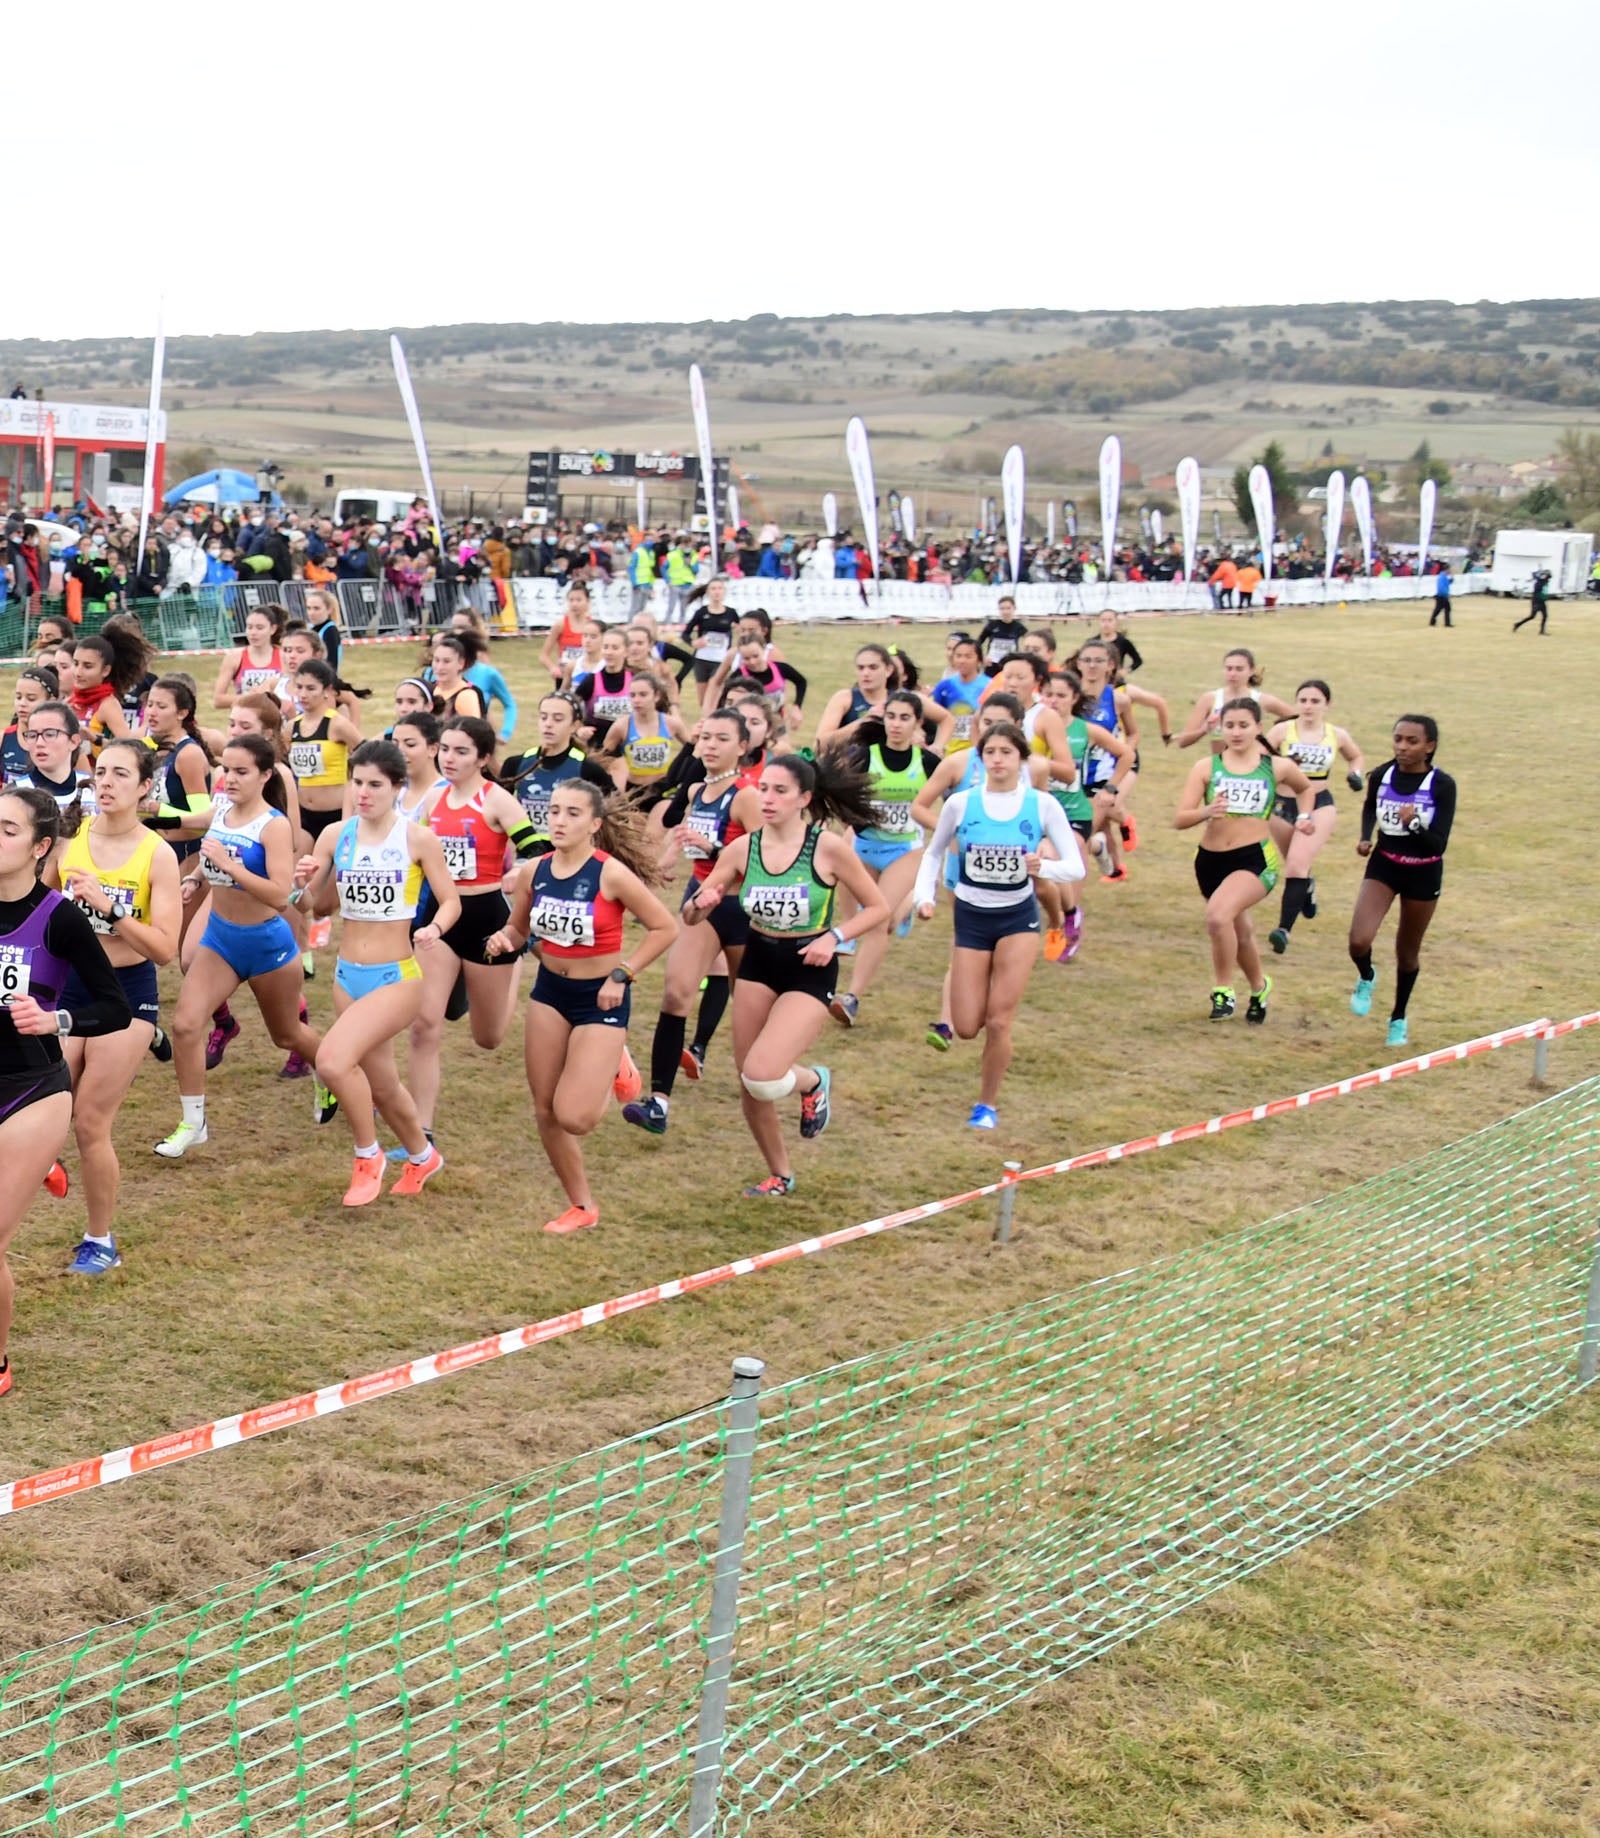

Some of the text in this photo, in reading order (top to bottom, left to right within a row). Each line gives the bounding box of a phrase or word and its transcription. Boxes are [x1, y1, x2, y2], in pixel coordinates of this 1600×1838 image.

[559, 453, 615, 475] Burgos
[635, 453, 684, 474] Burgos
[973, 856, 1019, 872] 4553
[346, 884, 395, 904] 4530
[751, 900, 800, 918] 4573
[536, 911, 583, 936] 4576
[33, 1475, 80, 1496] DIPUTACIÓN
